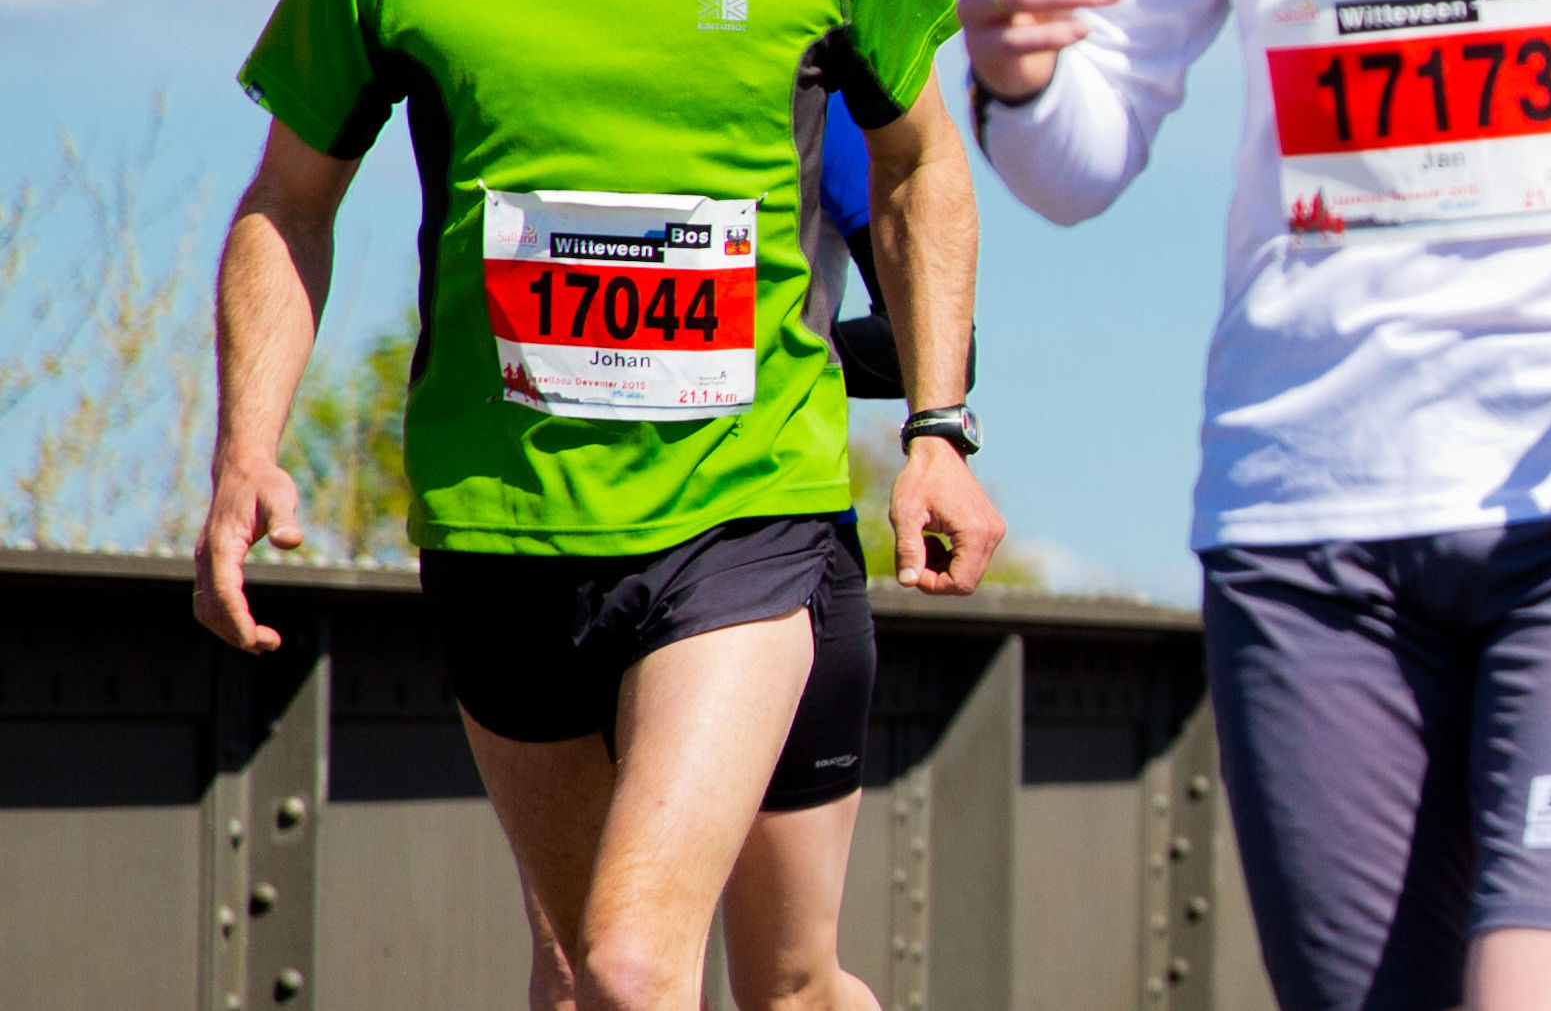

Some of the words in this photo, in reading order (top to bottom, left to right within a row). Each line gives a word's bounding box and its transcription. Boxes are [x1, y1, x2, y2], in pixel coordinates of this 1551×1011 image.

[1338, 1, 1468, 31] Witteveen
[671, 228, 709, 244] Bos
[555, 237, 653, 258] Witteveen
[529, 271, 719, 342] 17044
[589, 351, 651, 368] Johan
[715, 391, 737, 402] km
